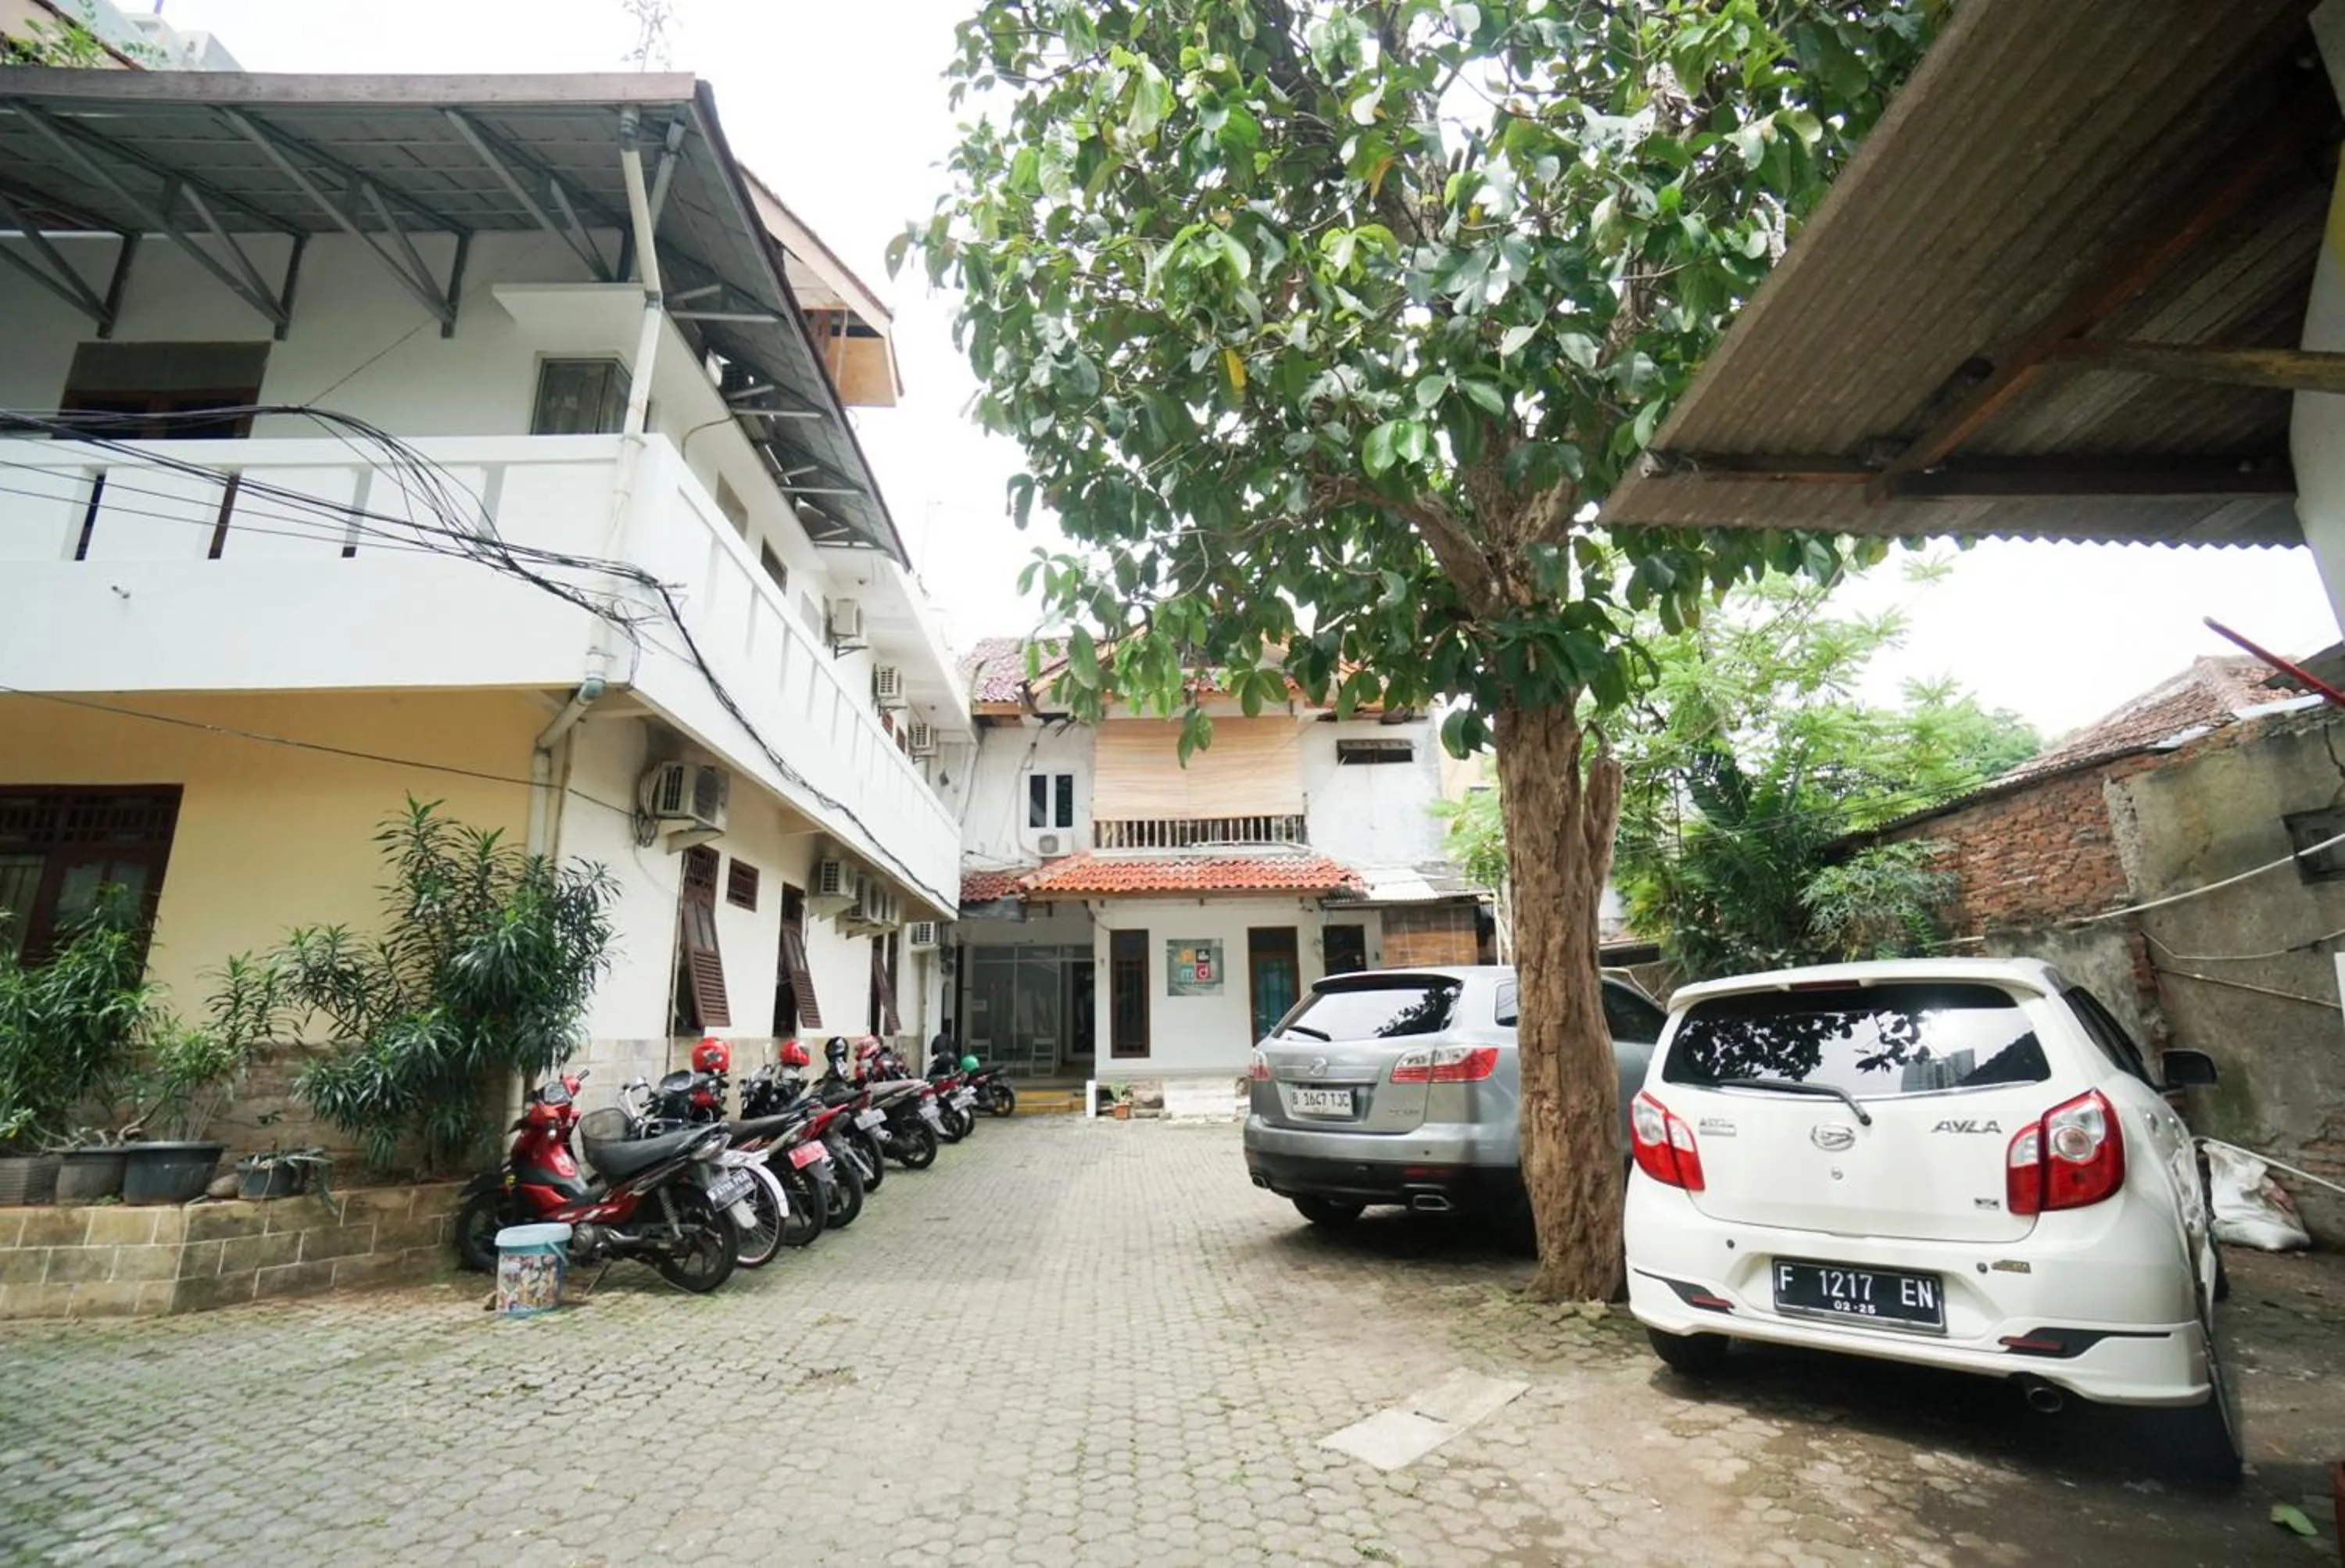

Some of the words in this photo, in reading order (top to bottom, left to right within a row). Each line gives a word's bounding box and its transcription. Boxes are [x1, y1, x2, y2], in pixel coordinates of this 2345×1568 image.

[1779, 1265, 1794, 1291] F
[1819, 1269, 1874, 1301] 1217
[1900, 1278, 1935, 1309] EN
